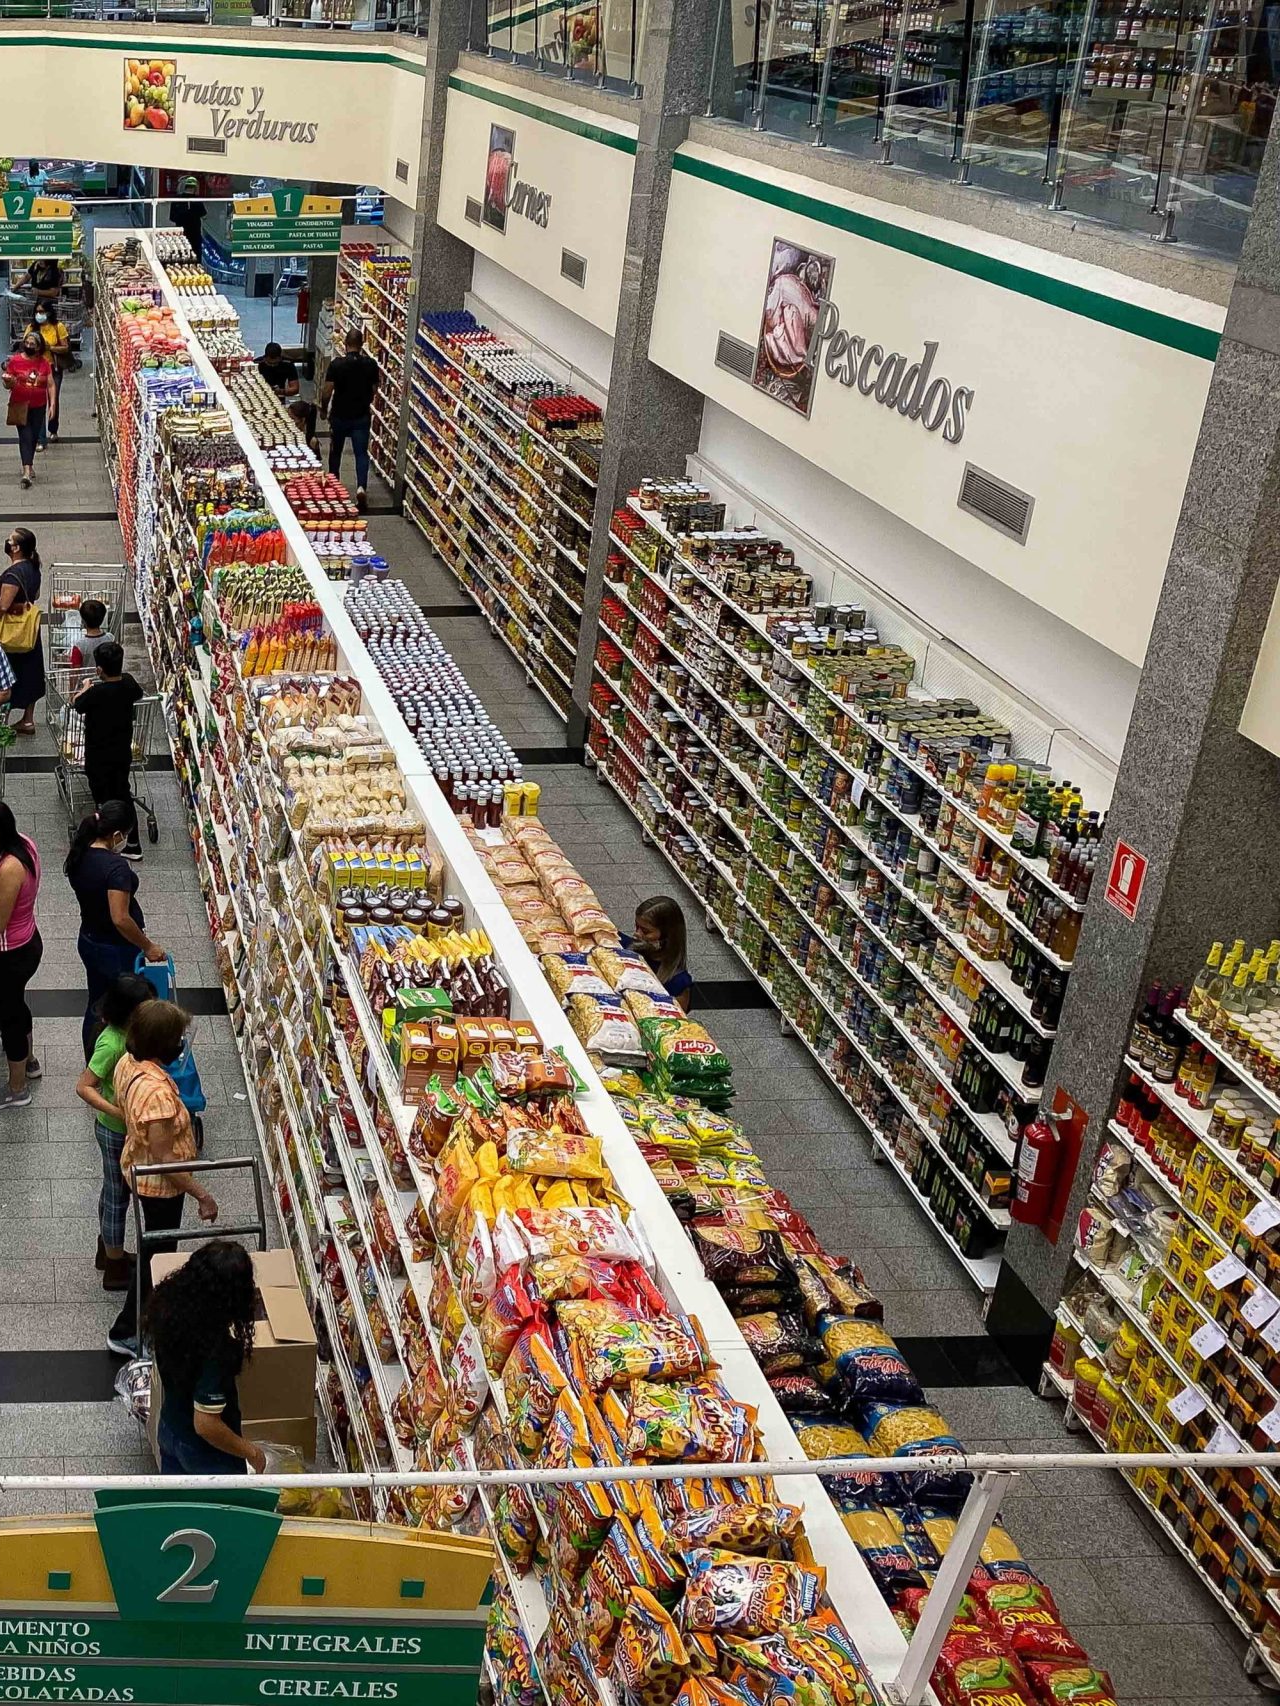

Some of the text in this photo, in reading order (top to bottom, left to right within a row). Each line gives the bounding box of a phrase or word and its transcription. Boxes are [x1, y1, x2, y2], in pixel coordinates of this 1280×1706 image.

[169, 74, 265, 113] Frutas y
[211, 108, 319, 144] Verduras
[283, 193, 293, 212] 1
[504, 160, 551, 229] Carnes
[13, 196, 25, 215] 2
[807, 297, 975, 444] Pescados
[675, 1041, 715, 1054] Capri
[157, 1529, 219, 1602] 2
[1001, 1610, 1055, 1626] RONCO
[27, 1637, 101, 1656] NIÑOS
[246, 1633, 422, 1655] INTEGRALES
[259, 1679, 398, 1699] CEREALES
